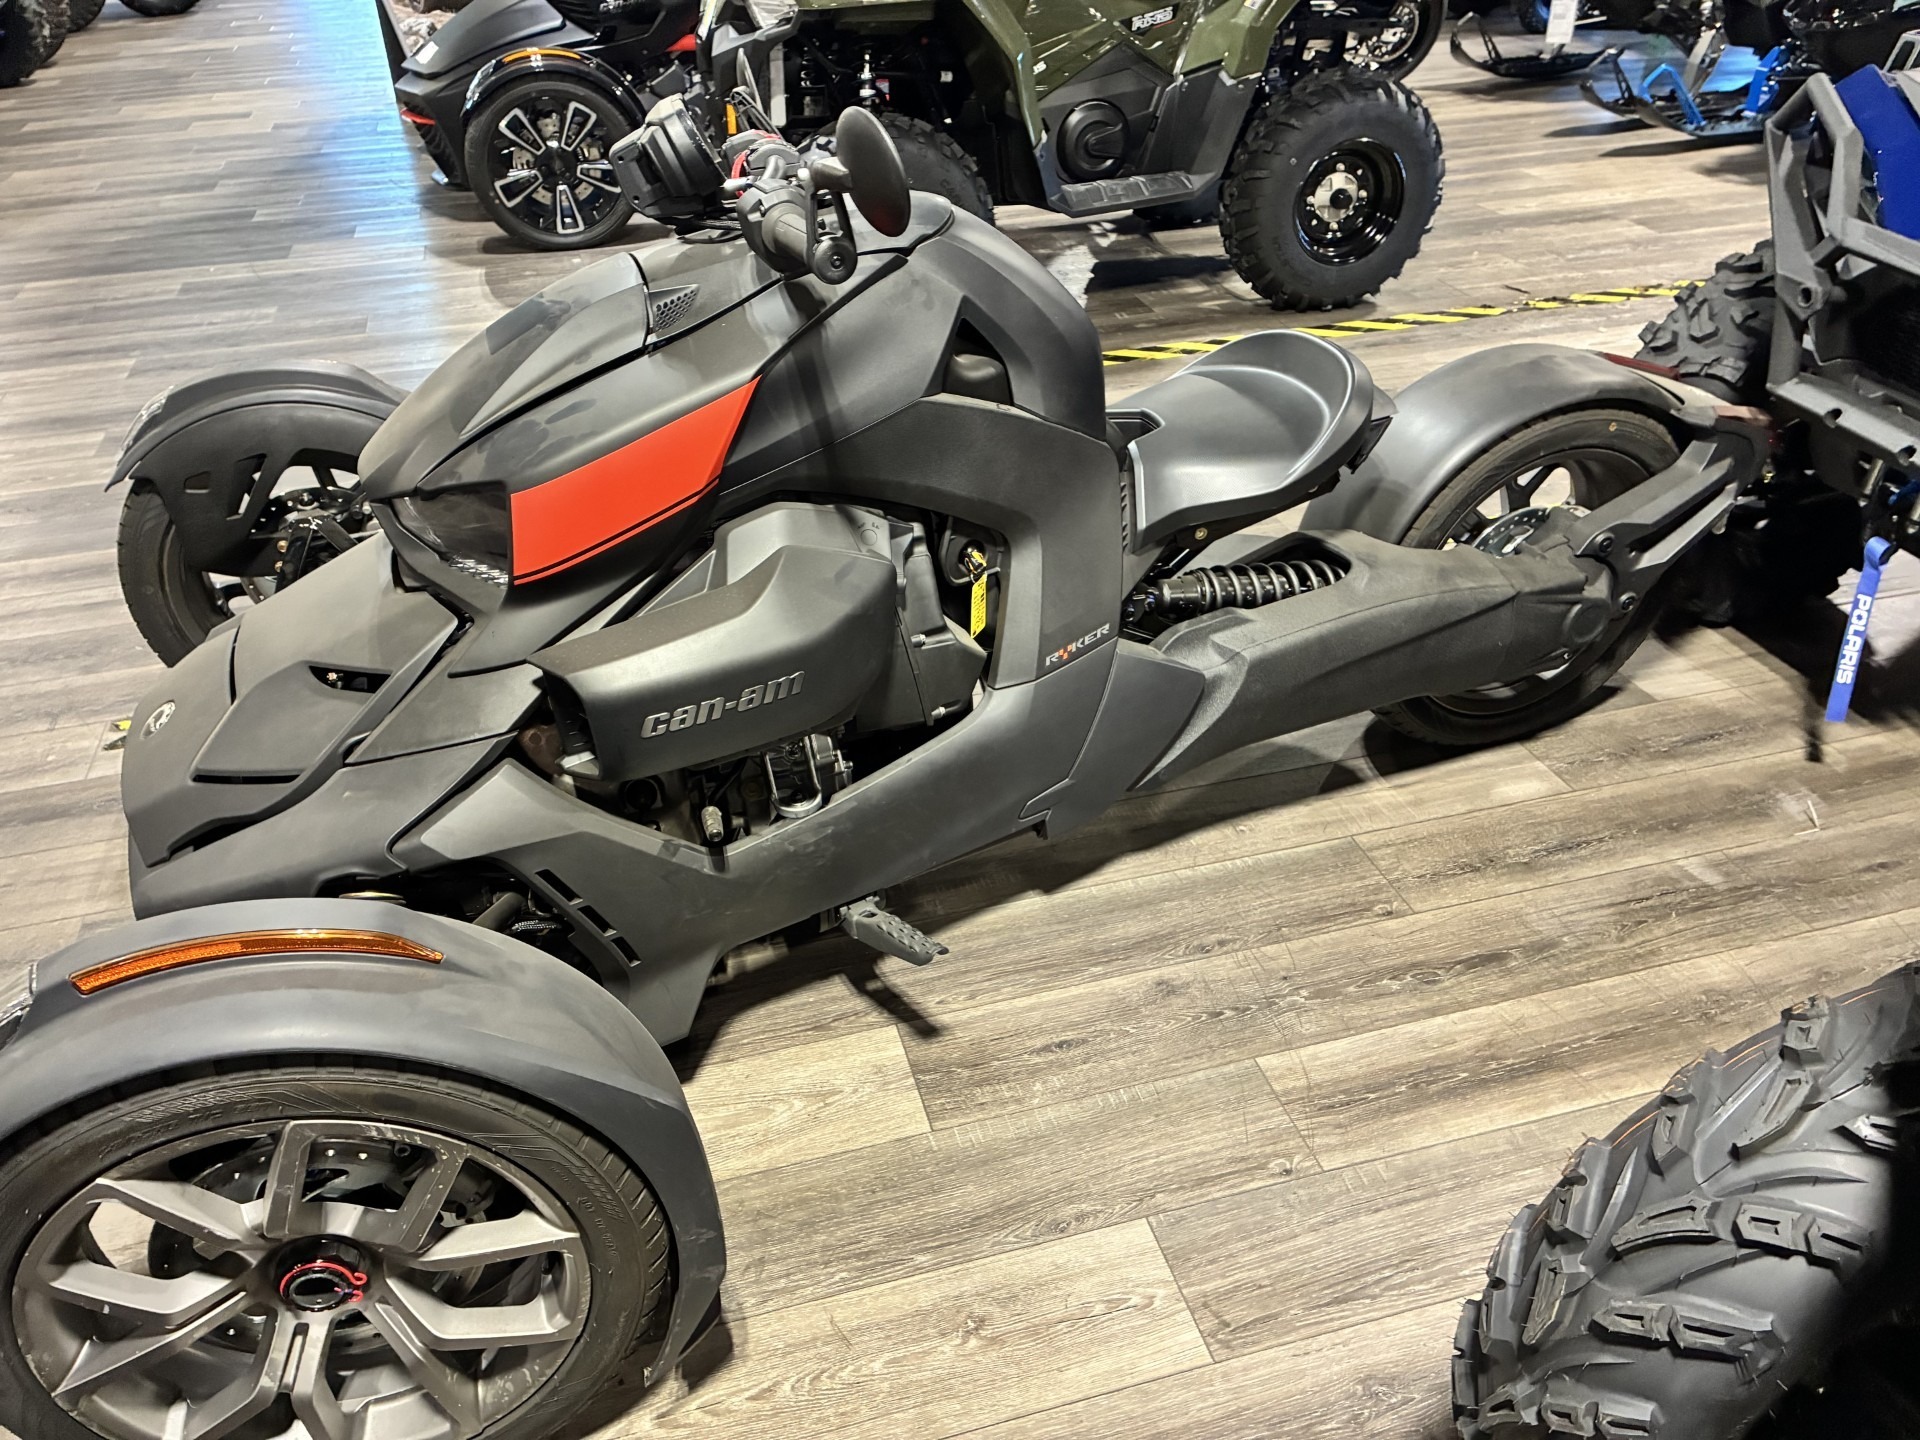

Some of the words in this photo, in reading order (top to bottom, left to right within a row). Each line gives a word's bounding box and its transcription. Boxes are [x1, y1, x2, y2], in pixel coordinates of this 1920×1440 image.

[1045, 622, 1110, 667] RYKER
[1836, 593, 1872, 685] POLARIS
[640, 670, 805, 738] can-am
